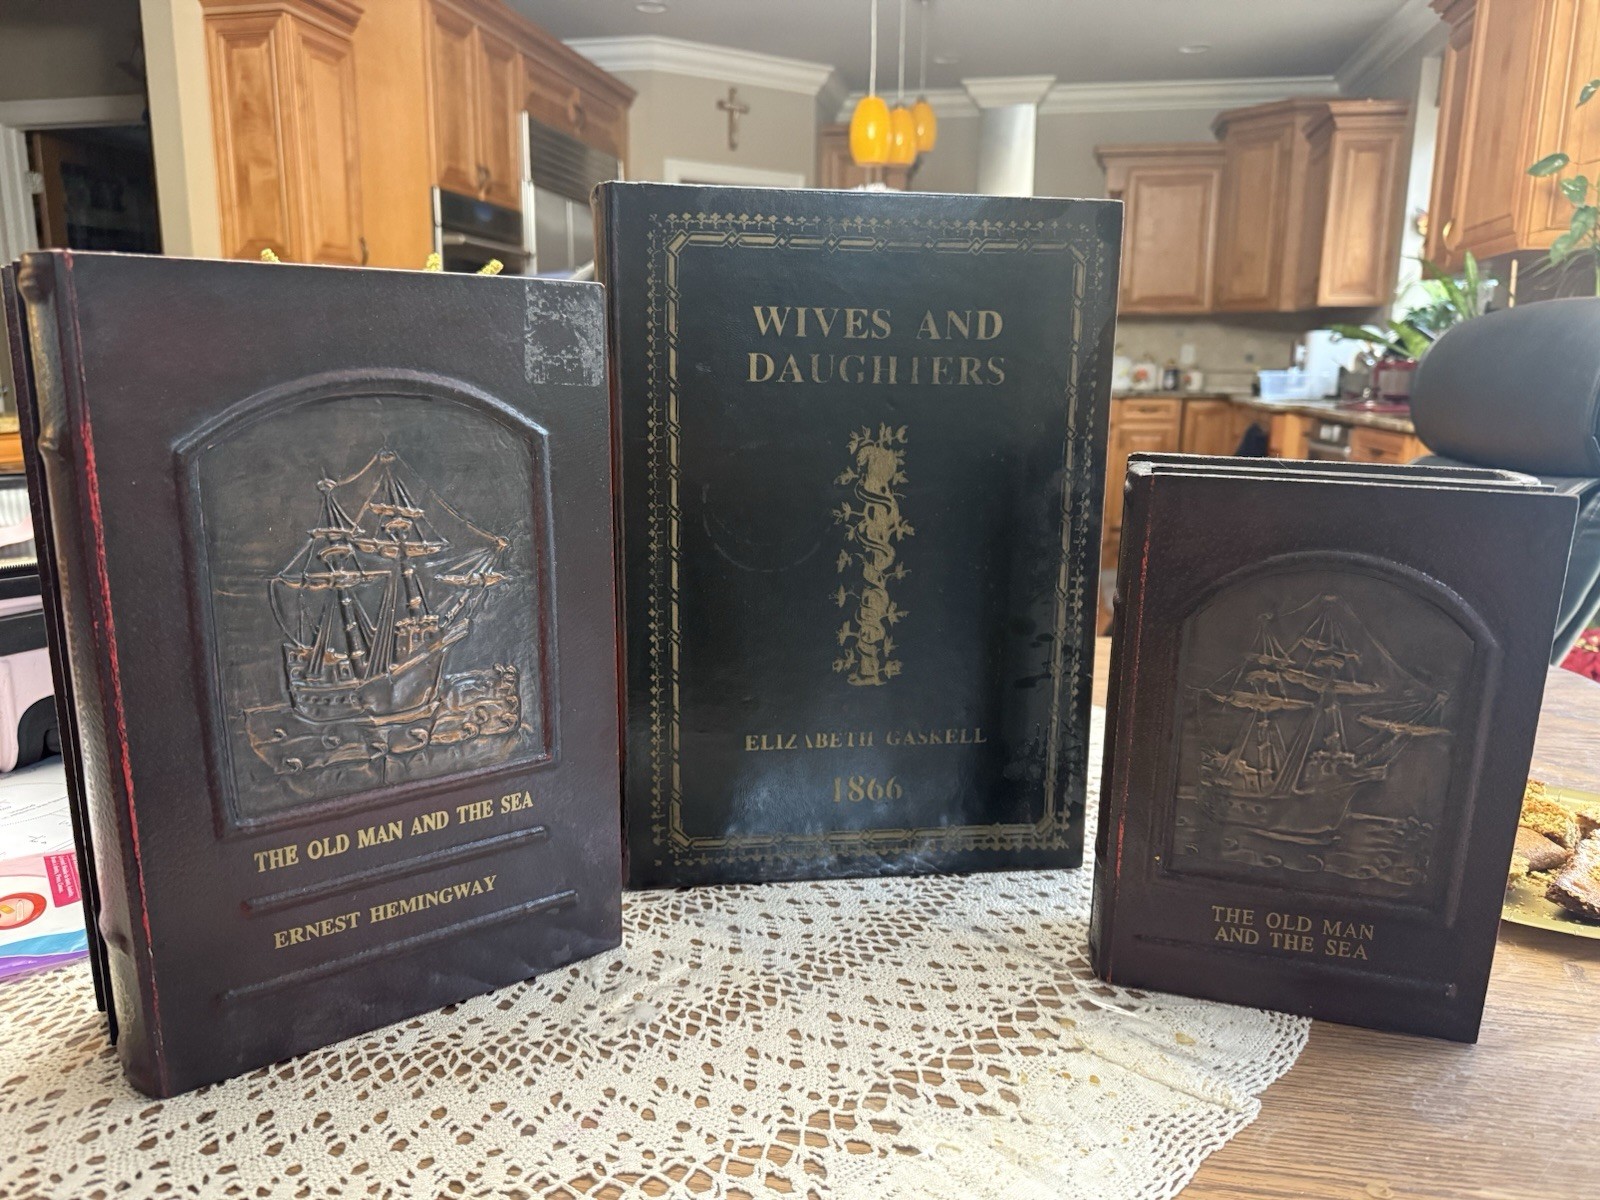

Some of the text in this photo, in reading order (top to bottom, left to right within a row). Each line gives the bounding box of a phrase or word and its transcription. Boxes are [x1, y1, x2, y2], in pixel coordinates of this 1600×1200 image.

[753, 305, 1004, 341] WIVES AND
[832, 774, 904, 803] 1866
[254, 790, 535, 873] THE OLD MAN AND THE SEA
[274, 875, 497, 949] ERNEST HEMINGWAY
[1211, 905, 1375, 941] THE OLD MAN
[1214, 926, 1369, 961] AND THE SEA
